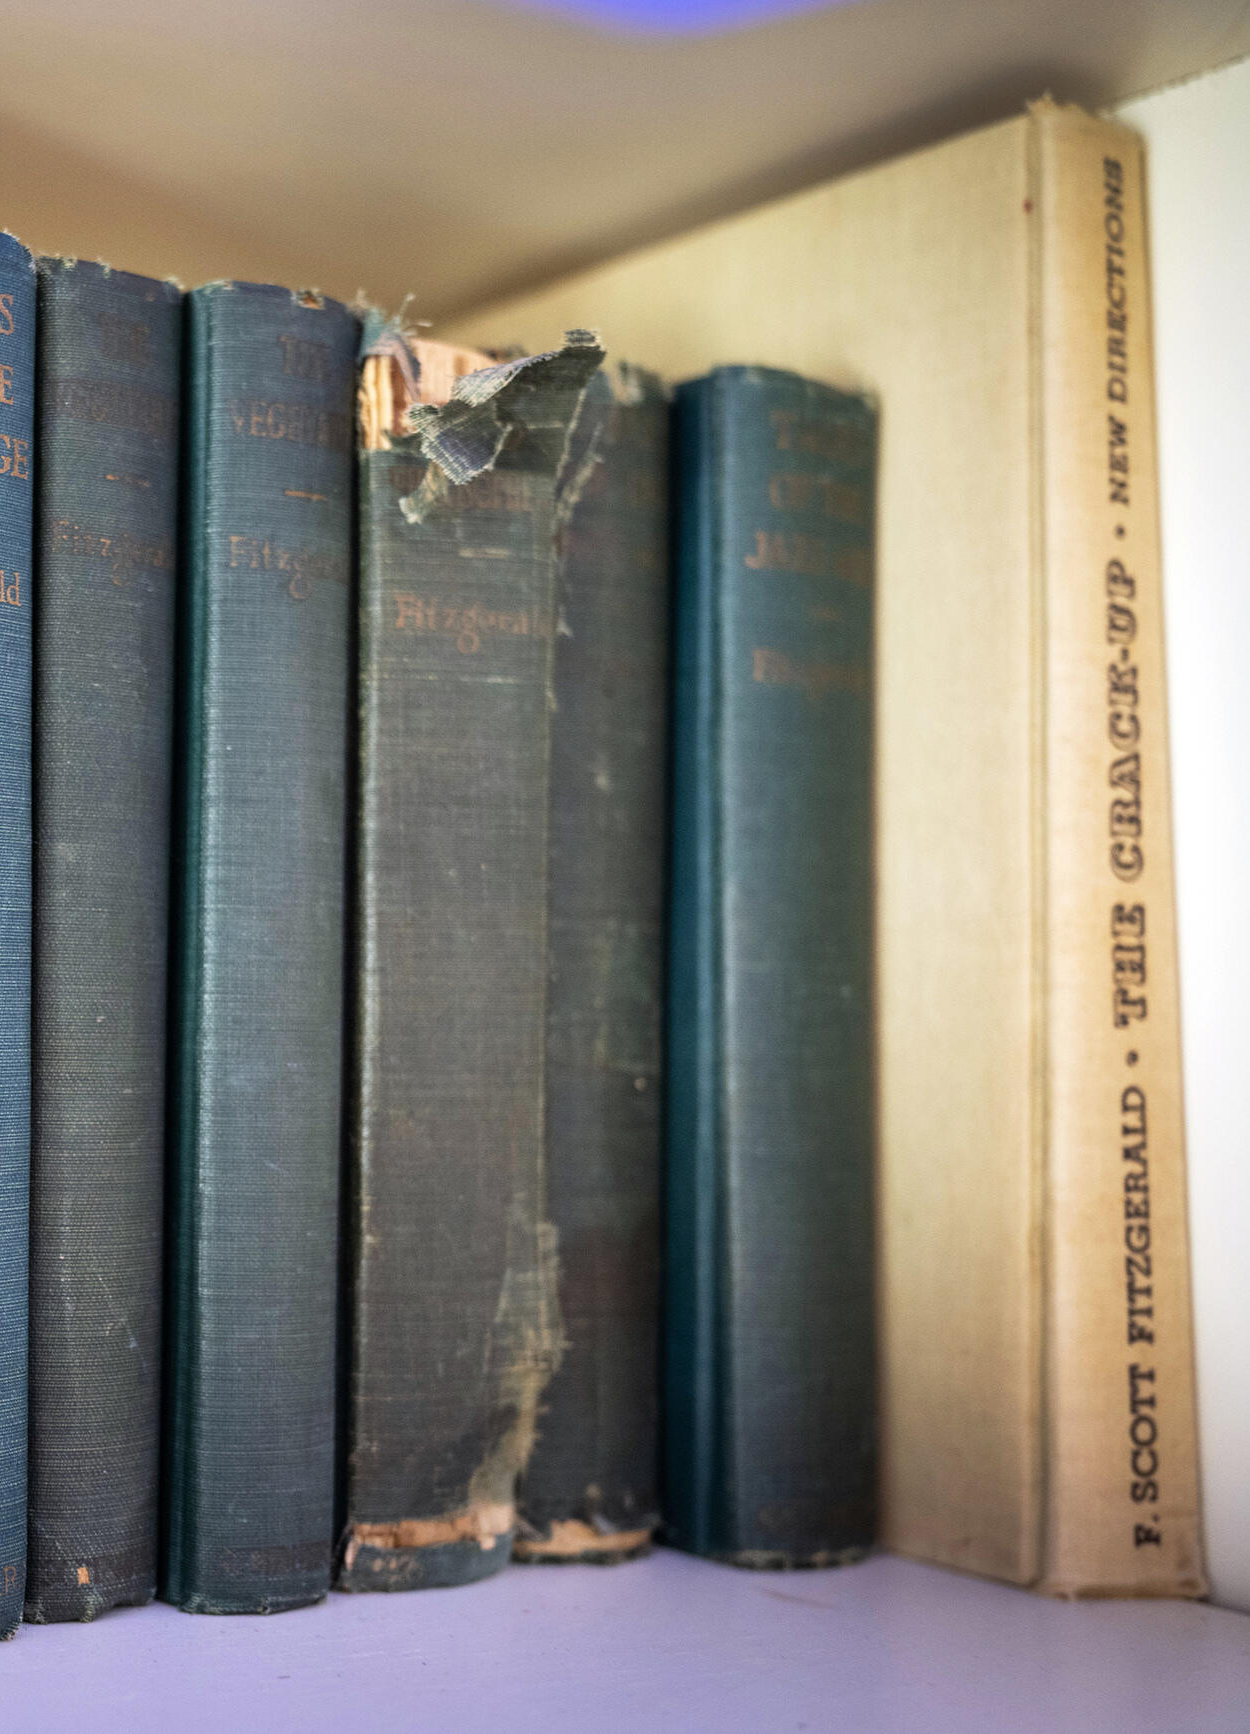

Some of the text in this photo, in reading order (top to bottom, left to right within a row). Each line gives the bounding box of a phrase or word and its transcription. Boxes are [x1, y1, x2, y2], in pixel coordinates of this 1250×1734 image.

[1102, 155, 1161, 1551] F. SCOTT FITZGERALD THE CRACK-UP NEW DIRECTIONS
